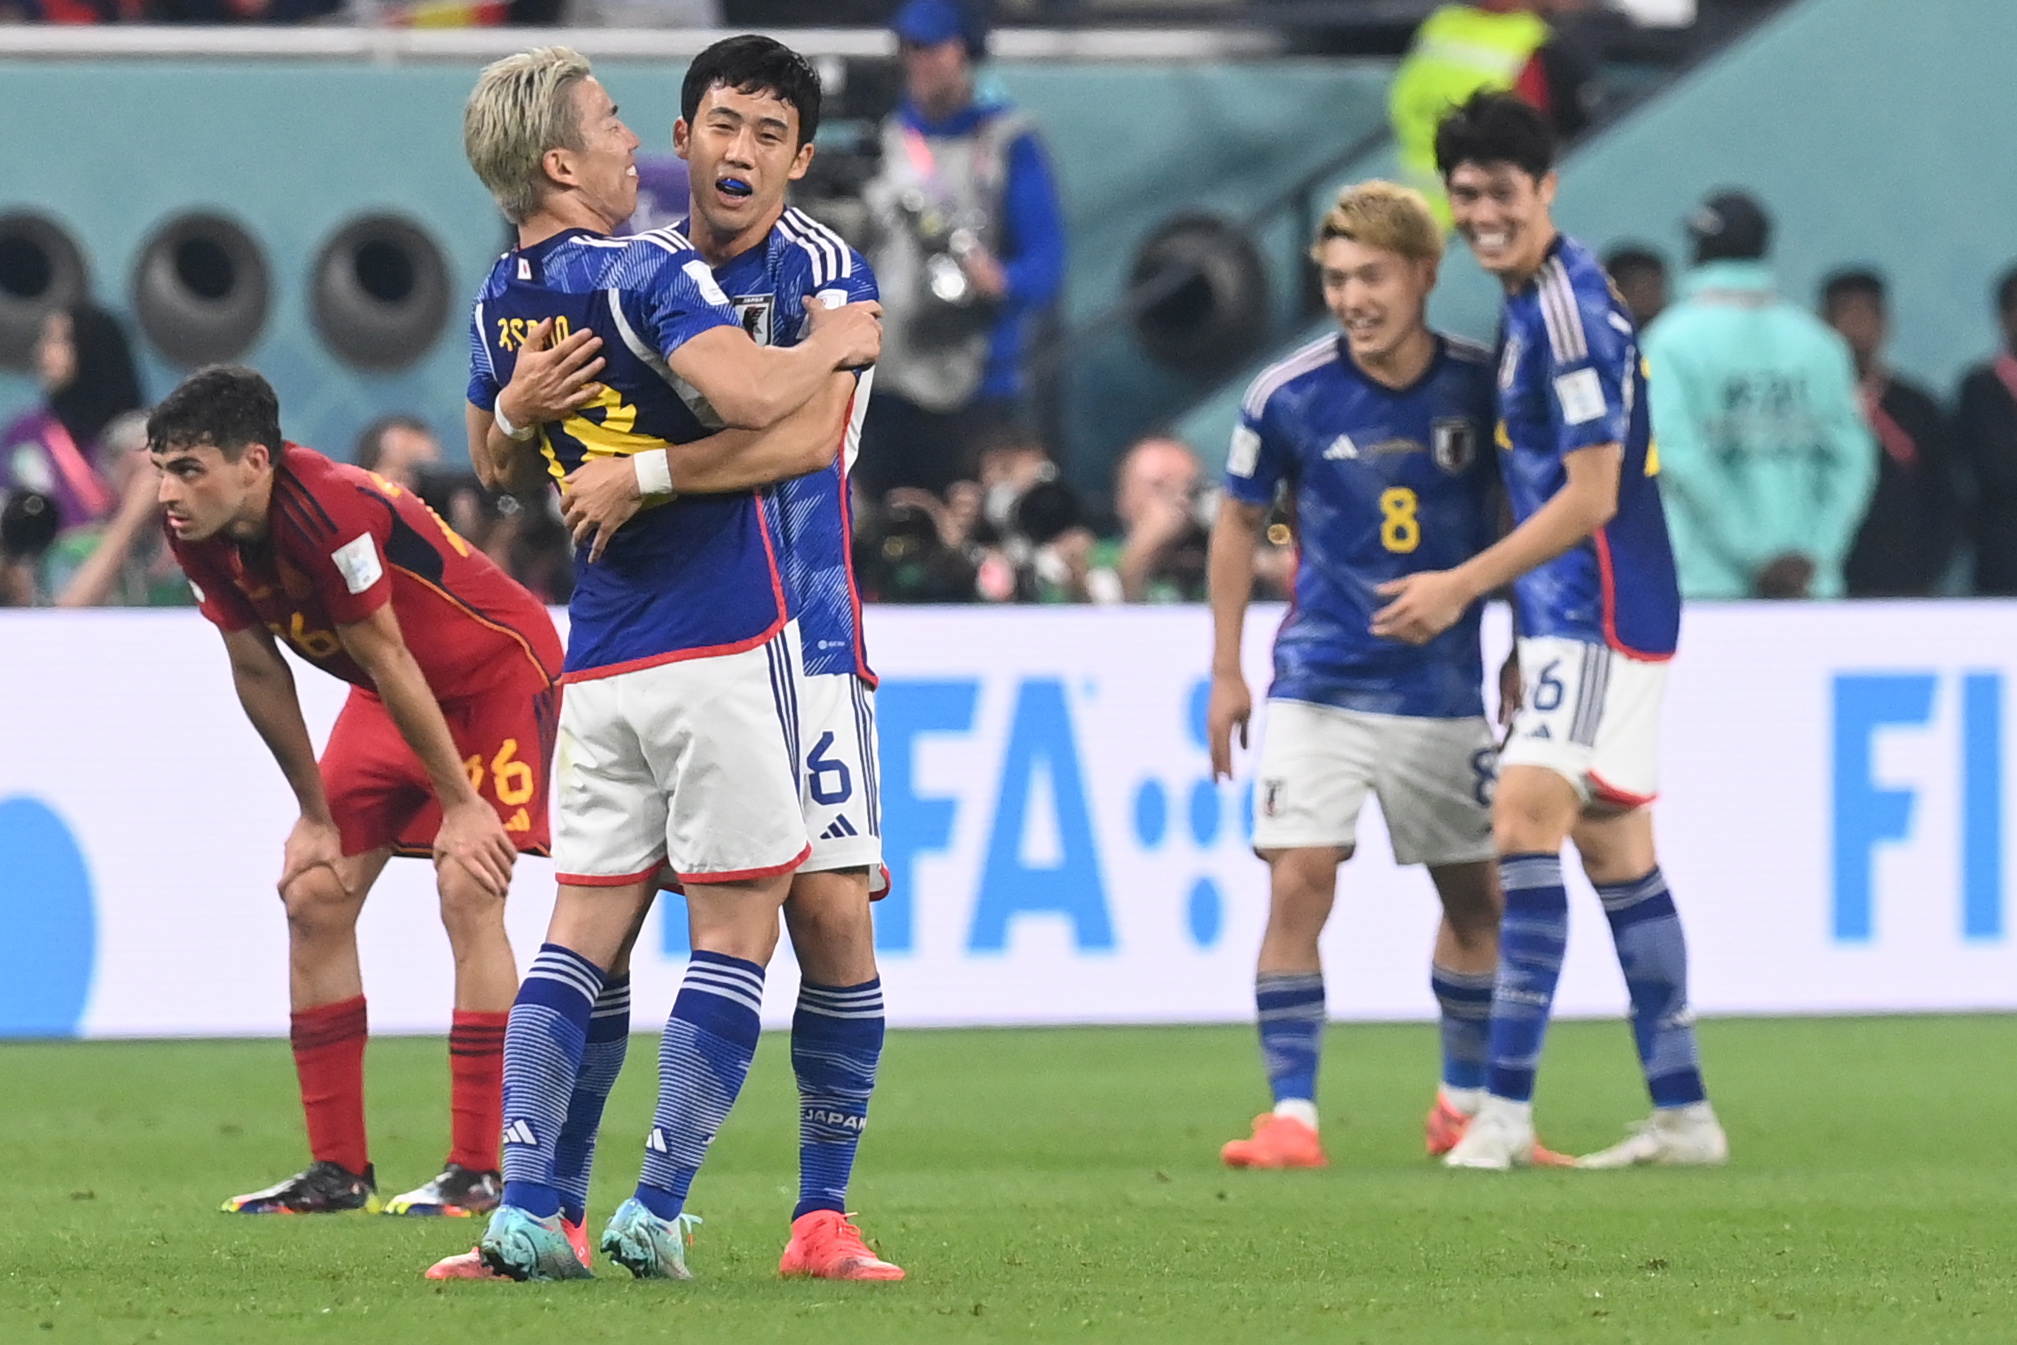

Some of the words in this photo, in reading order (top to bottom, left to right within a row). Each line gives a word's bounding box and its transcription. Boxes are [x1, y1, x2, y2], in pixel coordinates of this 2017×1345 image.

[497, 315, 570, 352] ASO
[1379, 487, 1421, 553] 8
[806, 731, 852, 805] 6
[1833, 674, 2001, 939] FI
[805, 1109, 868, 1131] JAPAN
